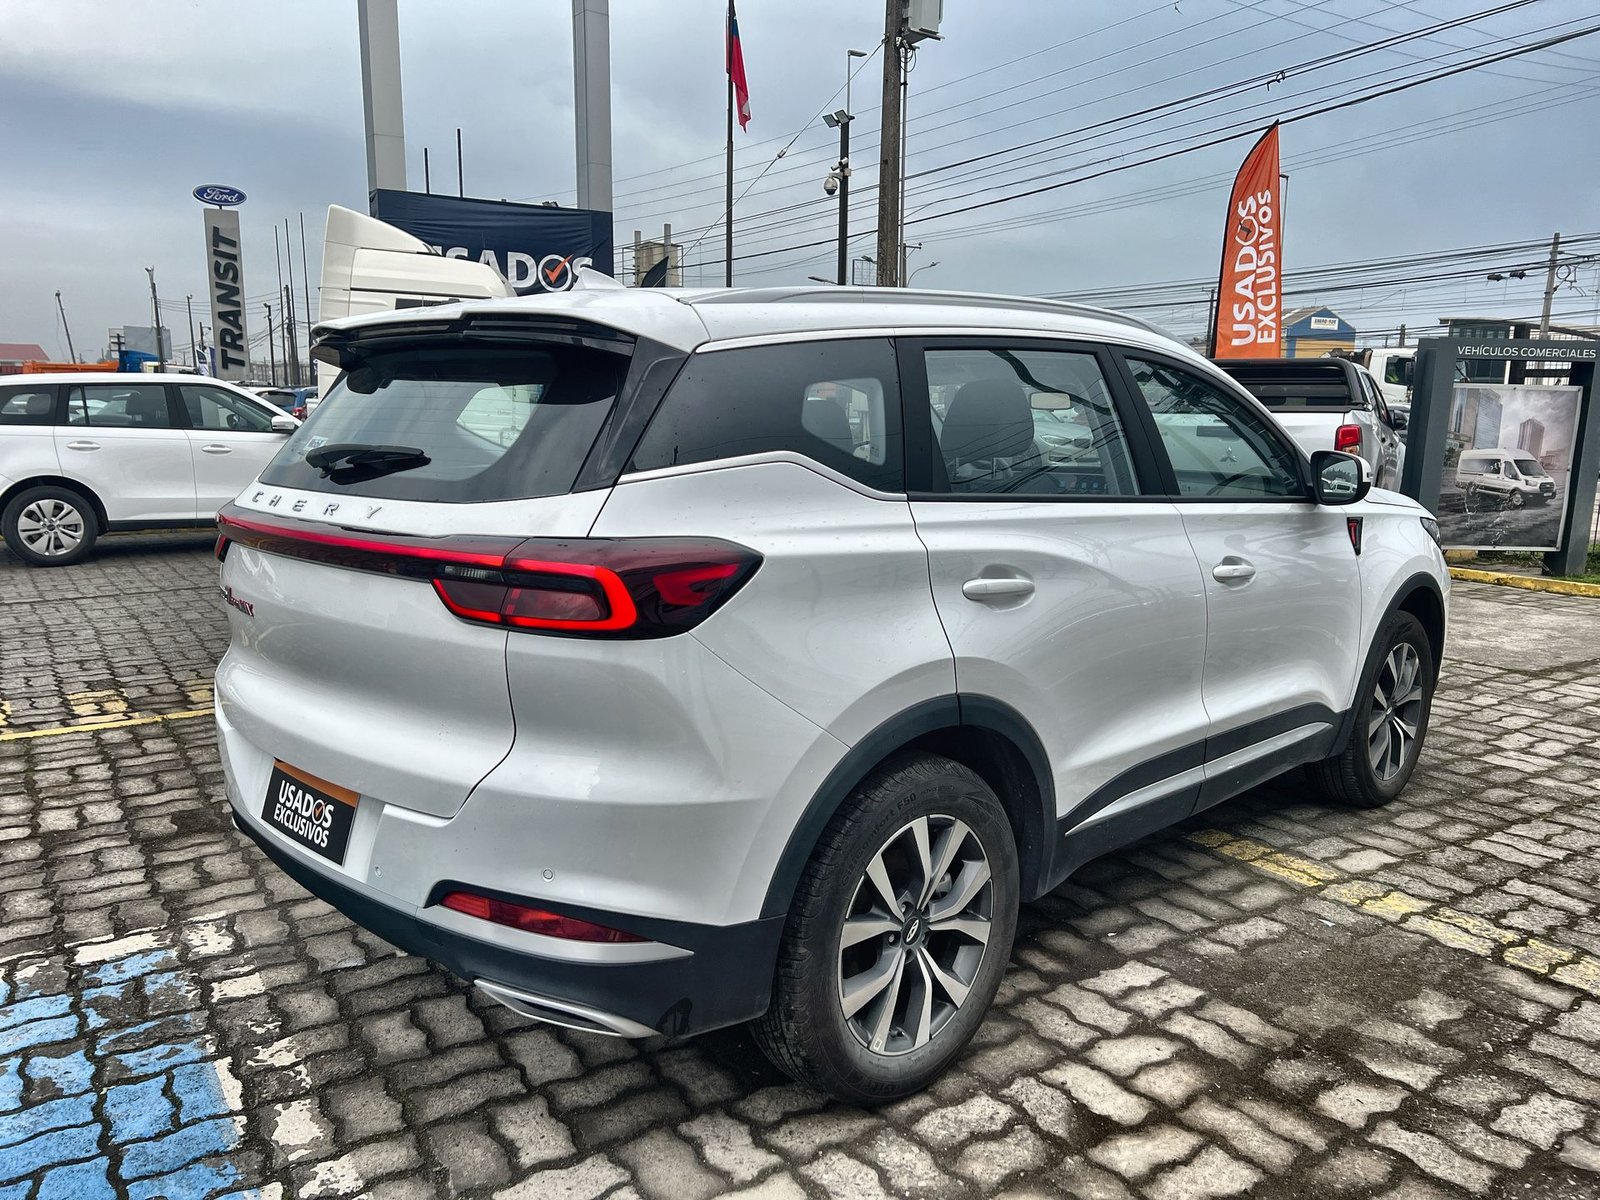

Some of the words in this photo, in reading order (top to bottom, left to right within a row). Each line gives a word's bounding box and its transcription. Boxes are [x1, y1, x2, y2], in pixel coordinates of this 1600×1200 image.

[203, 187, 239, 202] Ford
[432, 246, 593, 292] ADOS
[1231, 195, 1259, 346] USADOS
[1256, 189, 1276, 344] EXCLUSIVOS
[212, 226, 246, 372] TRANSIT
[1457, 344, 1519, 356] VEHÍCULOS
[1520, 347, 1597, 358] COMERCIALES
[251, 491, 383, 519] CHERY
[273, 803, 329, 848] EXCLUSIVOS
[279, 780, 334, 828] USADOS
